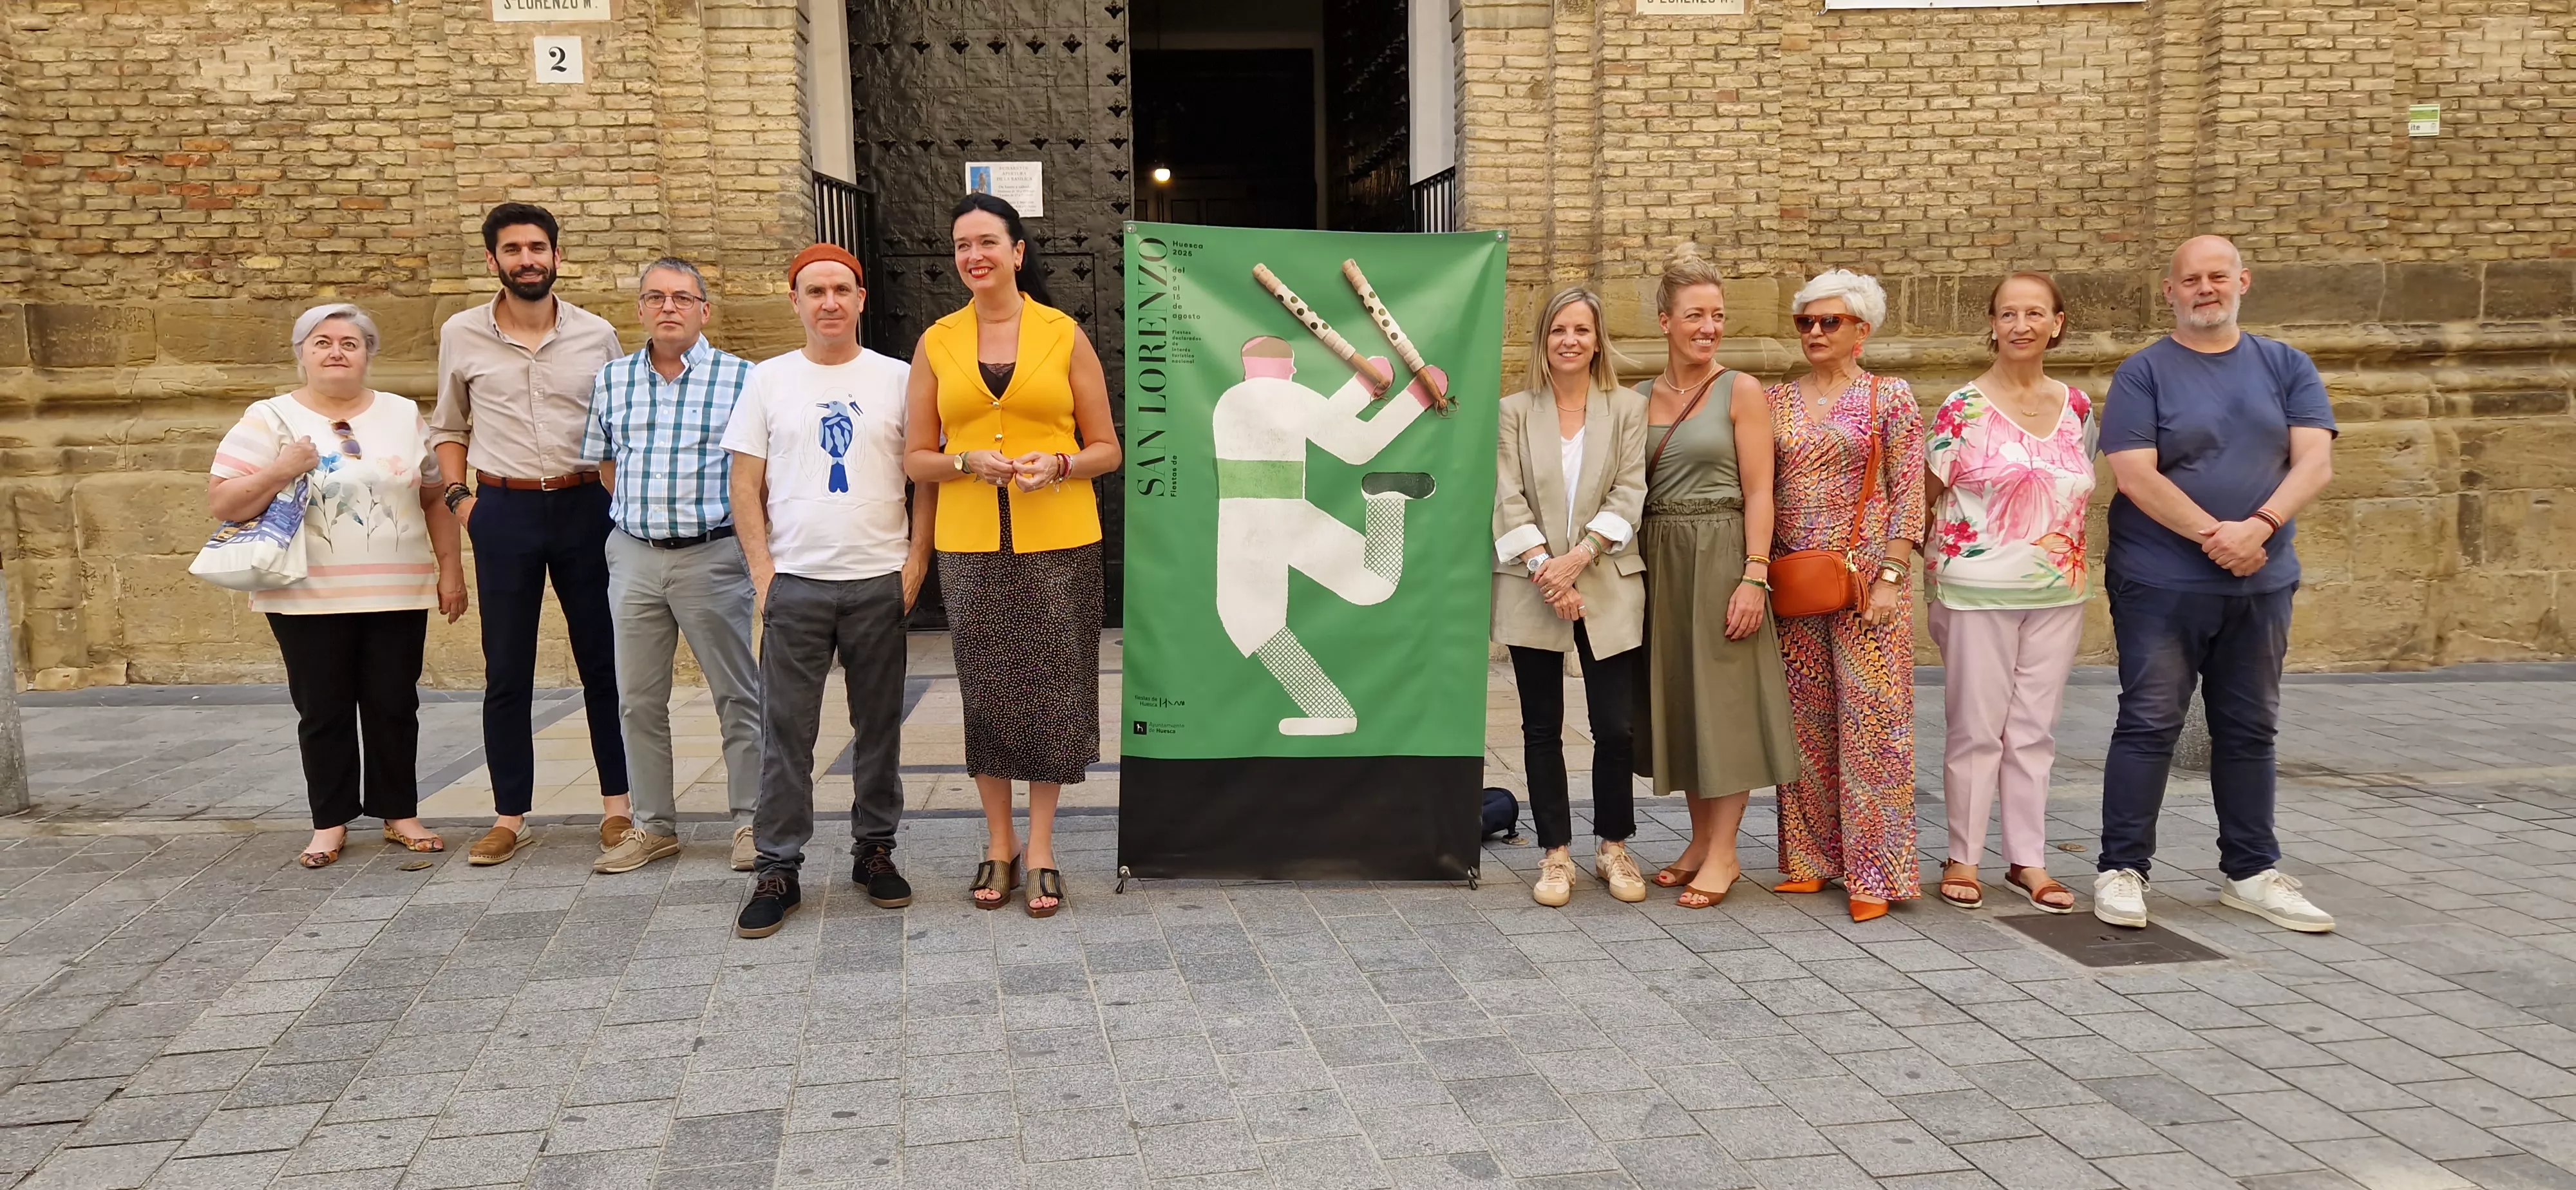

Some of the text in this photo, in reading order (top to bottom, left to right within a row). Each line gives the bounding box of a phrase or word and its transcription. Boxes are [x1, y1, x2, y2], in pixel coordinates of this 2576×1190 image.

[549, 46, 567, 72] 2
[1172, 240, 1204, 249] Huesca
[1172, 265, 1185, 274] del
[1137, 237, 1168, 497] SAN LORENZO
[1170, 455, 1178, 497] Fiestas de
